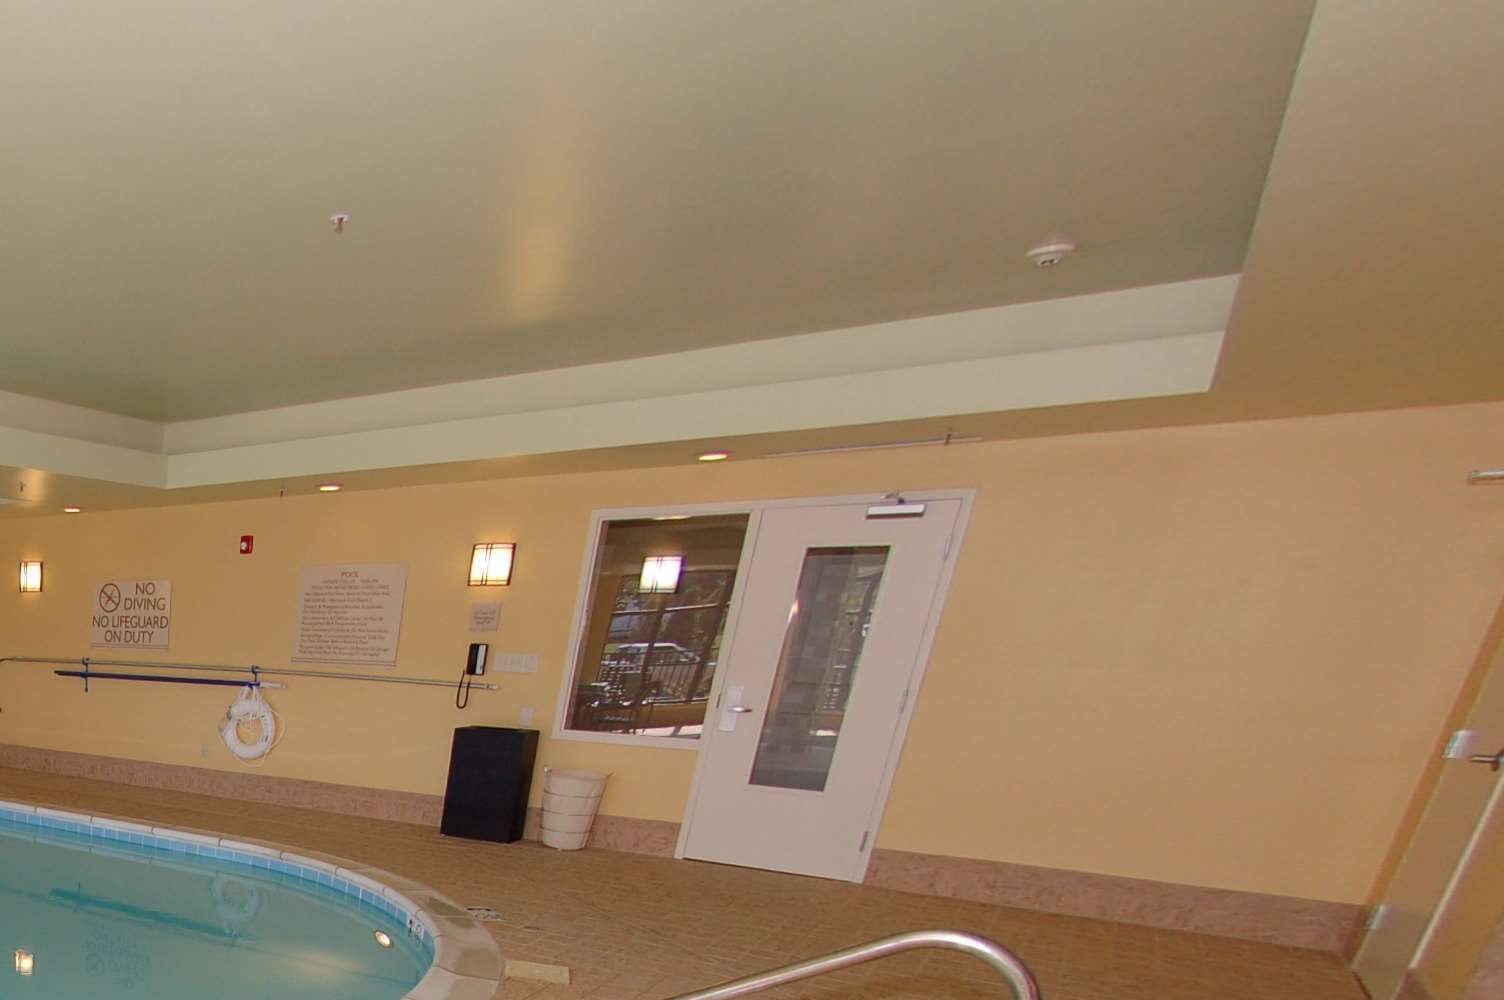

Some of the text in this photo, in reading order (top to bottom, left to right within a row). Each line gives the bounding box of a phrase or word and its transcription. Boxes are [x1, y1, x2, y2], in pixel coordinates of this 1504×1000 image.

[135, 582, 156, 595] NO
[124, 598, 166, 611] DIVING
[92, 615, 169, 629] NO LIFEGUARD
[104, 630, 154, 643] ON DUTY
